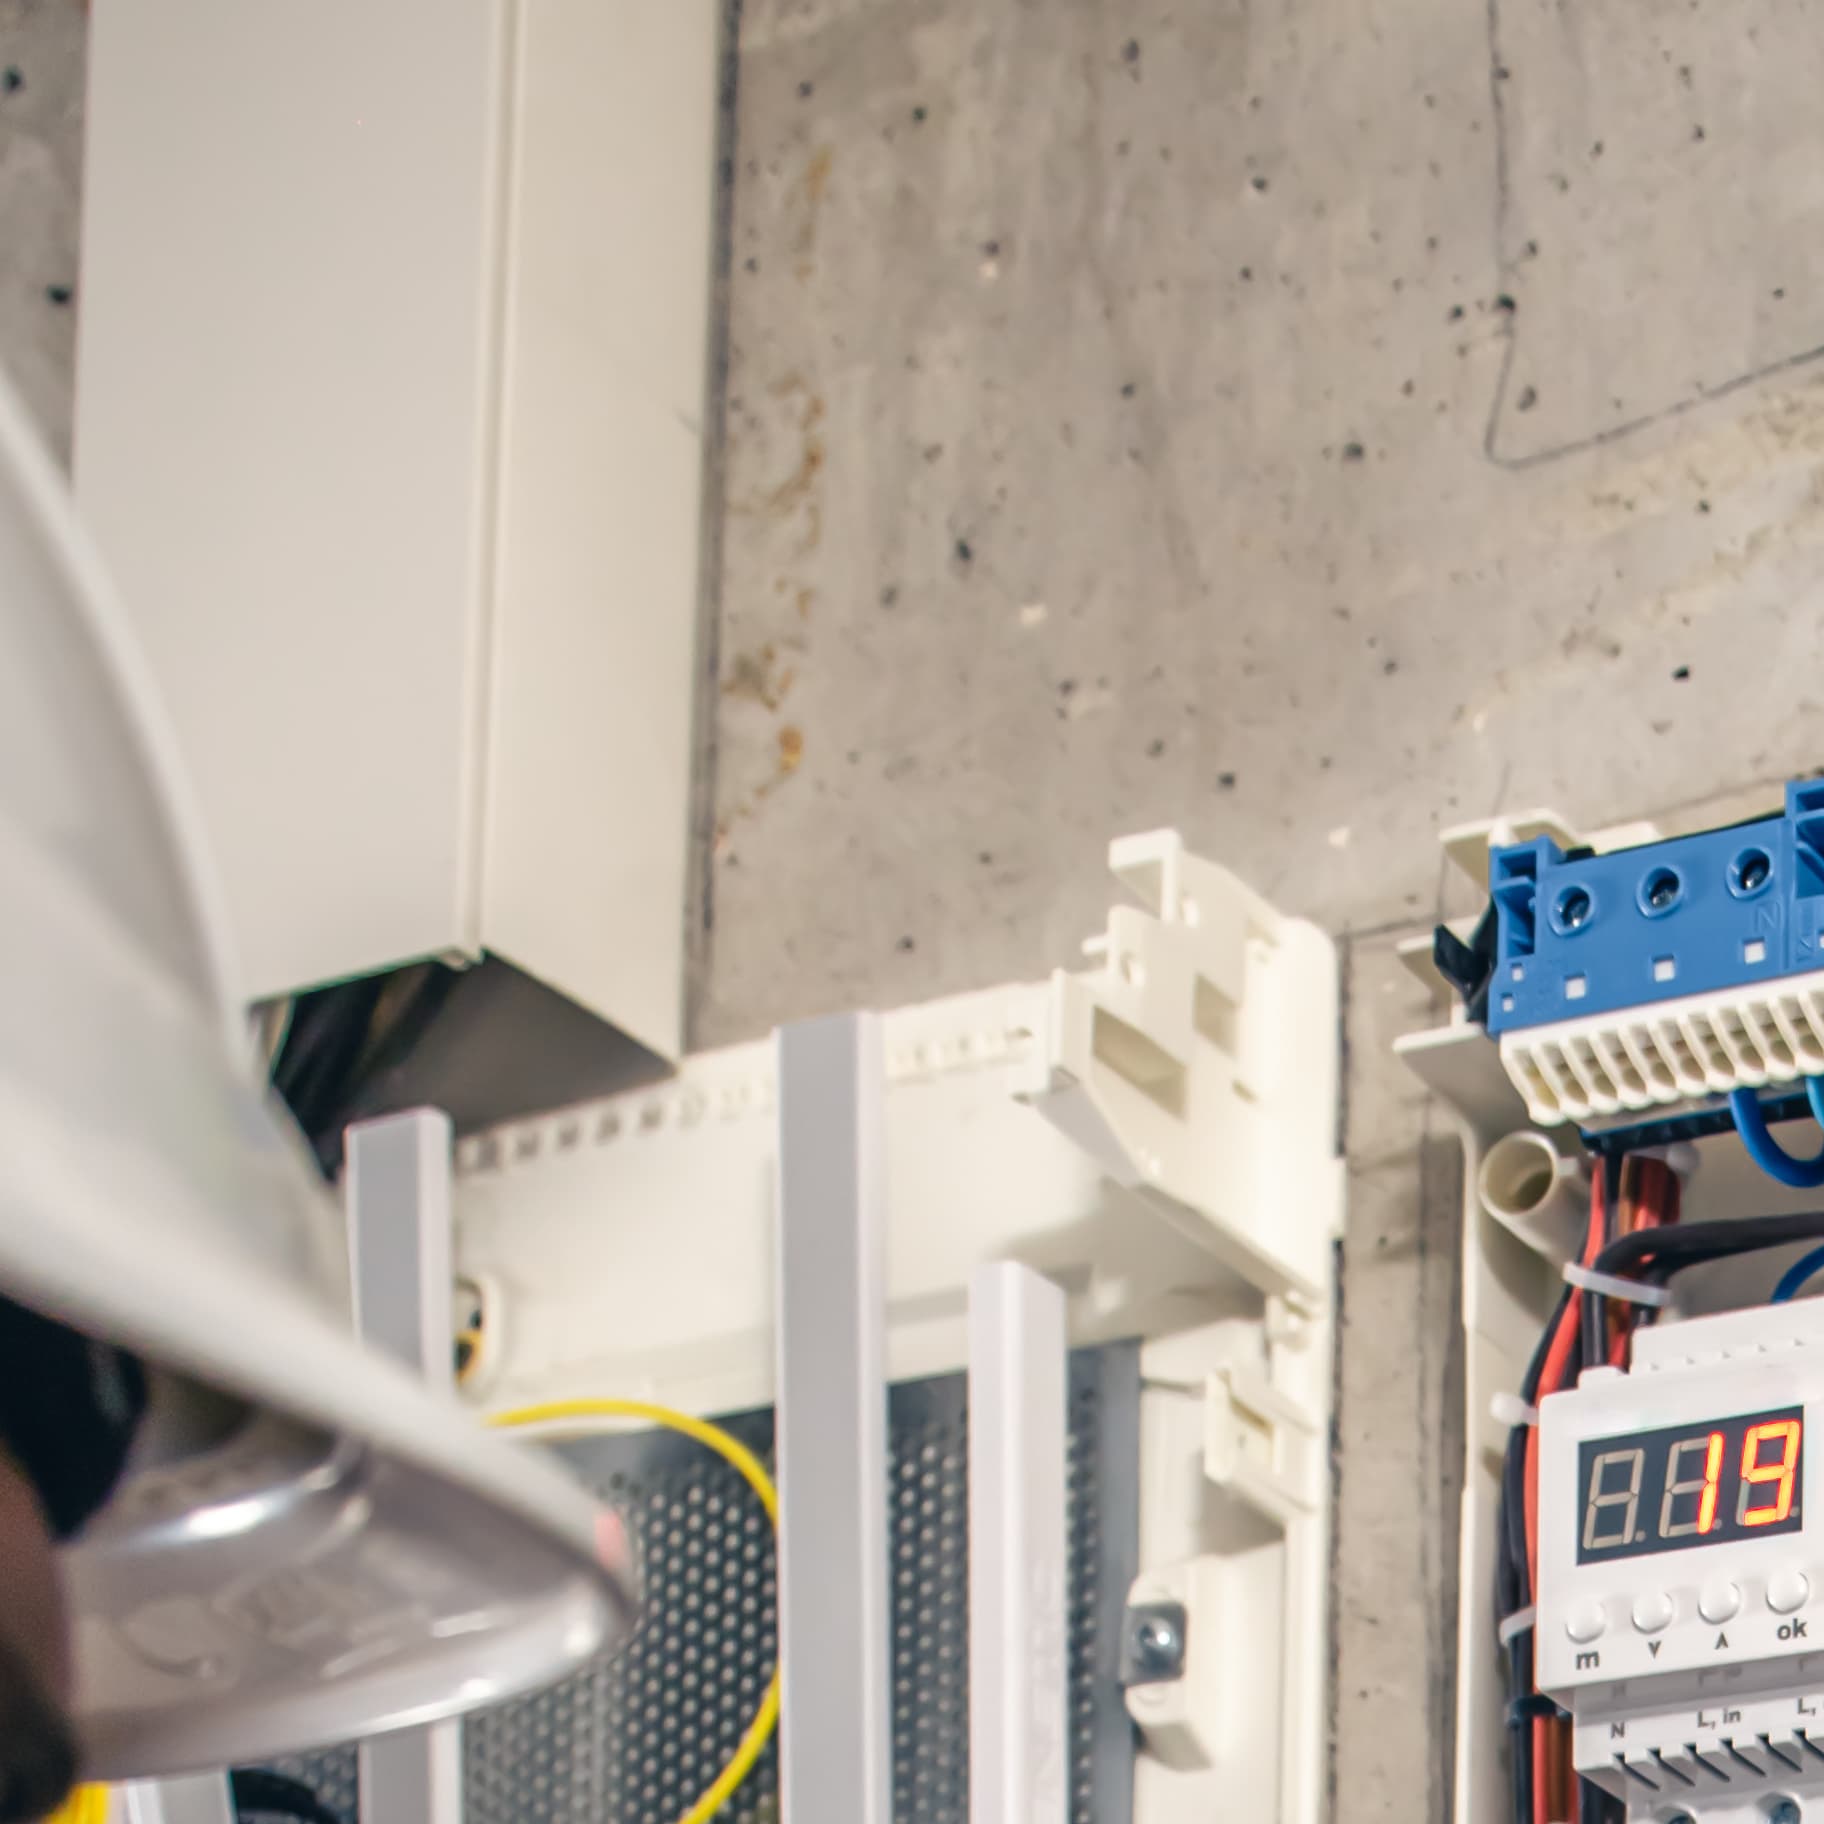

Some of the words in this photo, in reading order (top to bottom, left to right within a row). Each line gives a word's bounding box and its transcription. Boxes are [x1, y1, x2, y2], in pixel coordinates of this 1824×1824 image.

[1696, 1420, 1801, 1534] 19
[1776, 1618, 1808, 1641] ok
[1575, 1650, 1600, 1670] m
[1723, 1708, 1741, 1723] in
[1609, 1721, 1626, 1739] N
